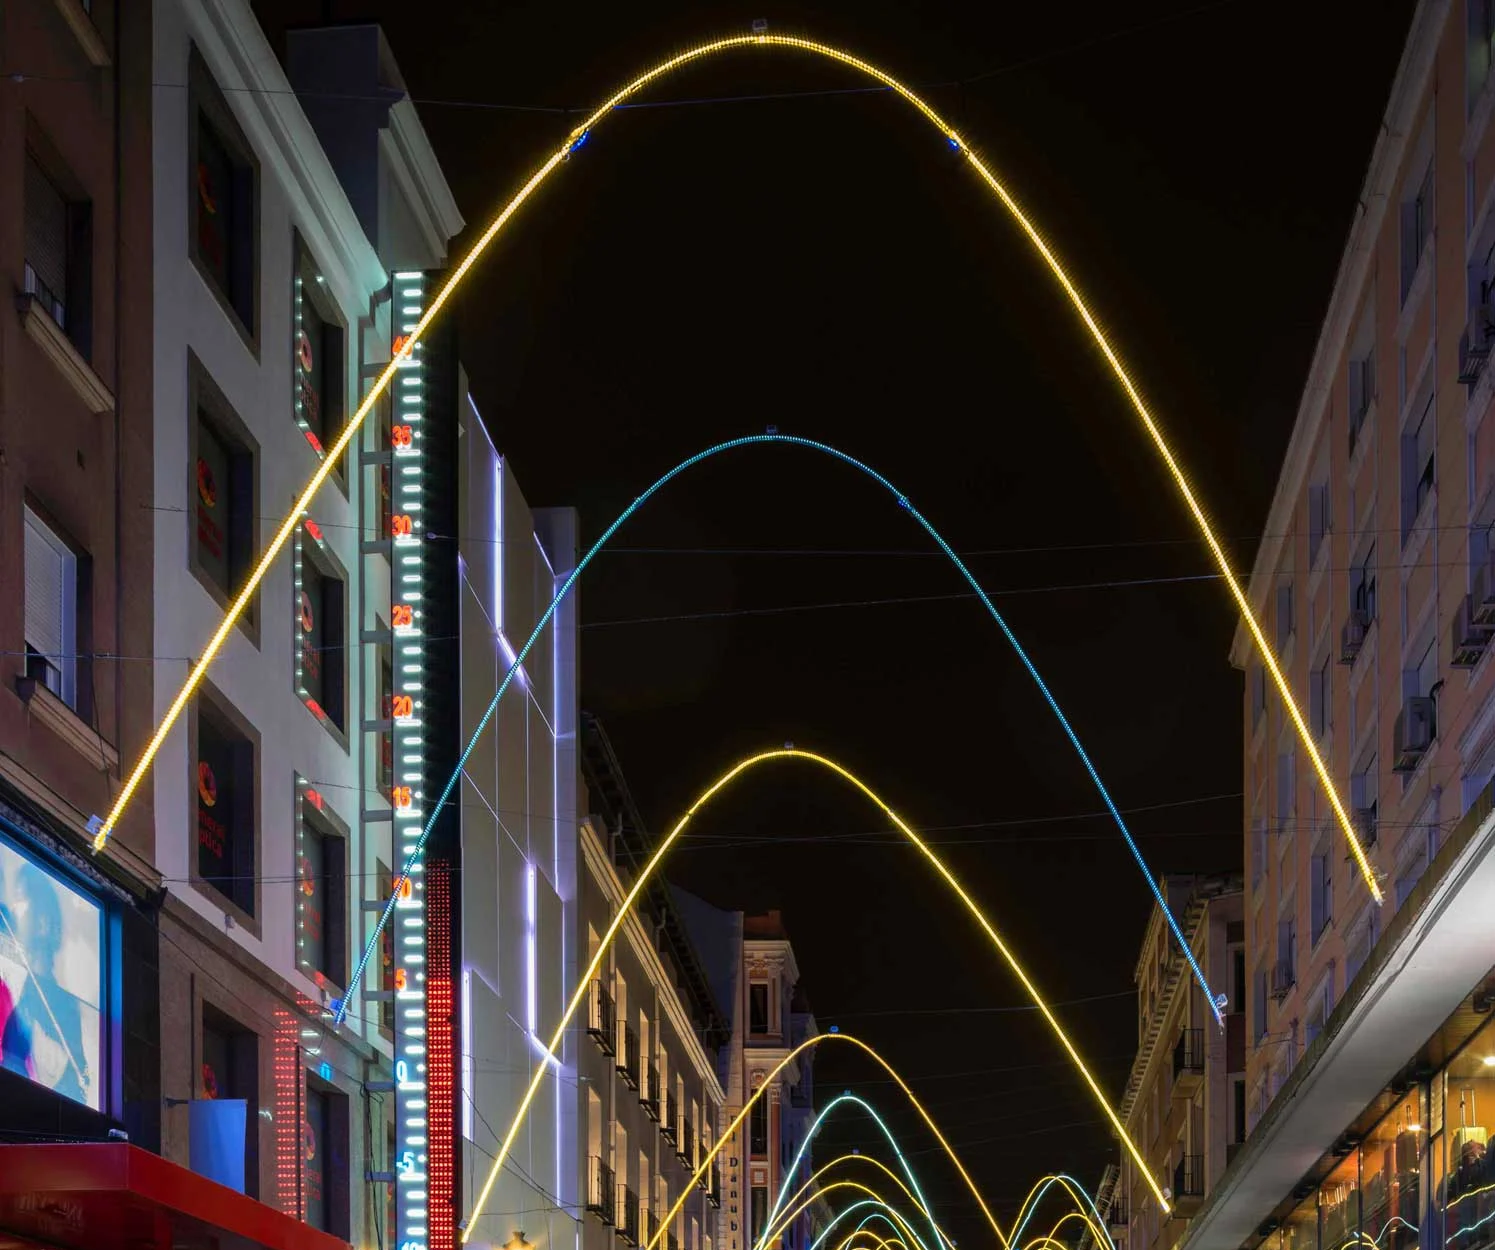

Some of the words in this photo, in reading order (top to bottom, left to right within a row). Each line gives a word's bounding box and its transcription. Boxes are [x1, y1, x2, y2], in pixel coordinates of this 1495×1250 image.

[392, 425, 412, 447] 35
[391, 515, 412, 536] 30
[392, 605, 412, 627] 25
[392, 696, 413, 717] 20
[393, 787, 411, 807] 15
[395, 968, 407, 989] 5
[396, 1061, 408, 1083] 0
[396, 1152, 414, 1173] -5
